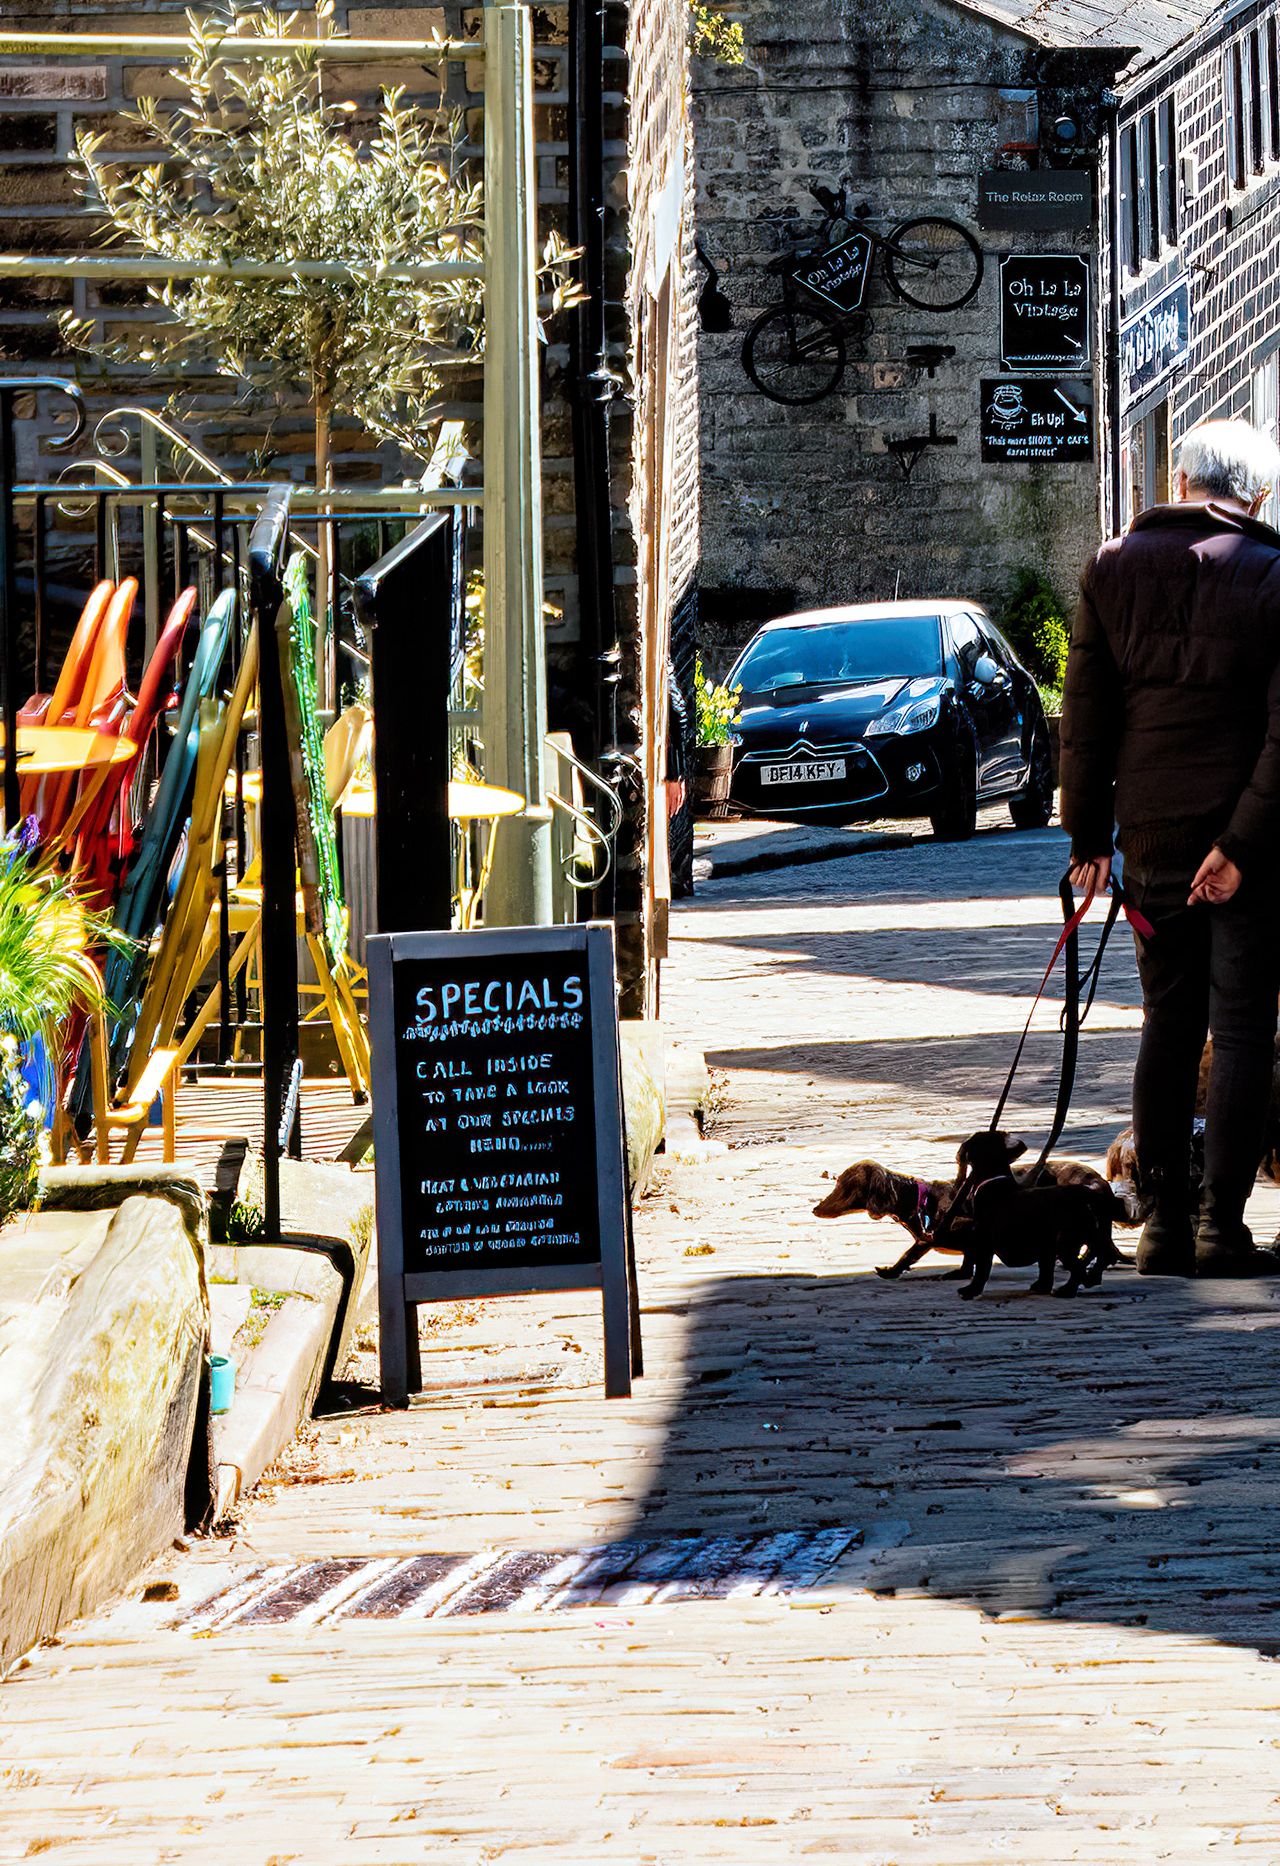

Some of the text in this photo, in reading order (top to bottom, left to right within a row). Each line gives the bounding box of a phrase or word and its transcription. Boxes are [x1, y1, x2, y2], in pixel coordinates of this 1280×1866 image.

[986, 191, 1084, 203] The Relax Room
[807, 269, 830, 285] Oh
[1009, 278, 1082, 296] Oh La La
[1013, 302, 1079, 321] Vintage
[1031, 413, 1065, 428] Eh Up!
[414, 976, 584, 1025] SPECIALS
[416, 1053, 554, 1079] CALL INSIDE
[422, 1080, 570, 1104] TO TAKE A LOOK
[425, 1106, 576, 1132] AT OUR SPECIALS
